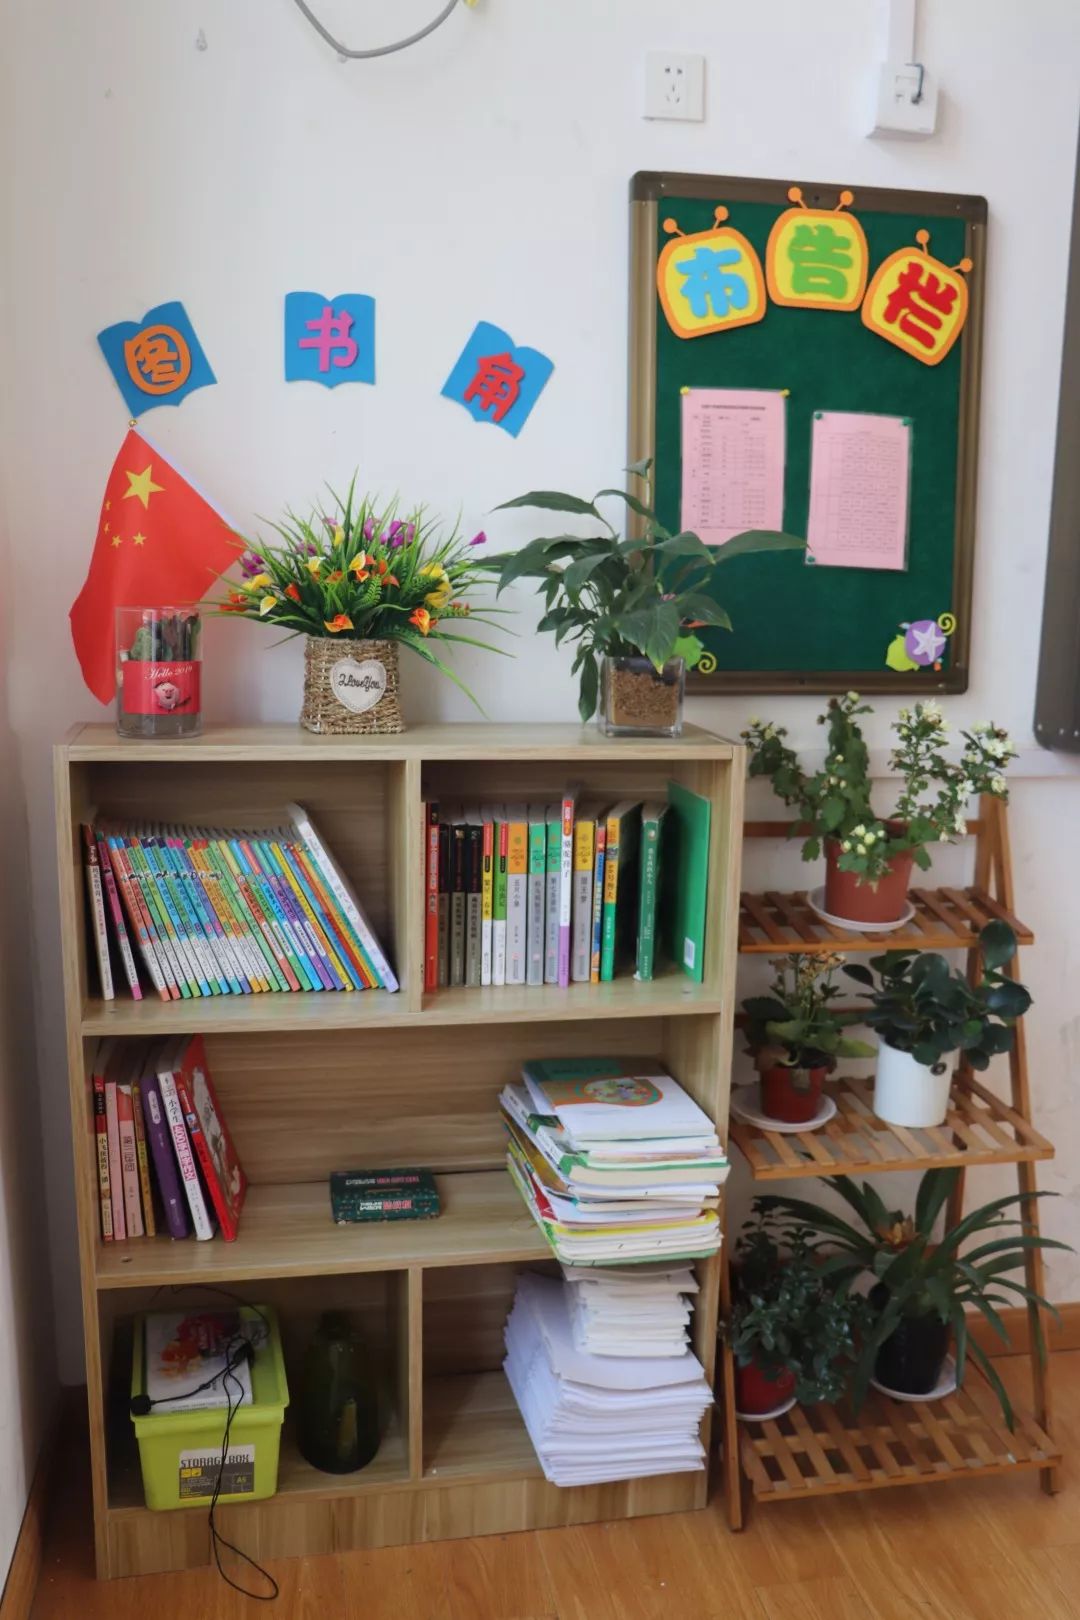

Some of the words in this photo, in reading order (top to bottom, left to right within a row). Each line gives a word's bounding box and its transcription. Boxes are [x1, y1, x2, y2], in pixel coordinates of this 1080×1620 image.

[675, 246, 750, 319] 布
[787, 223, 854, 300] 告
[882, 261, 959, 351] 栏
[123, 324, 192, 395] 图
[298, 306, 359, 373] 书
[462, 351, 526, 424] 角
[144, 667, 173, 680] Hello
[229, 1454, 249, 1465] BOX
